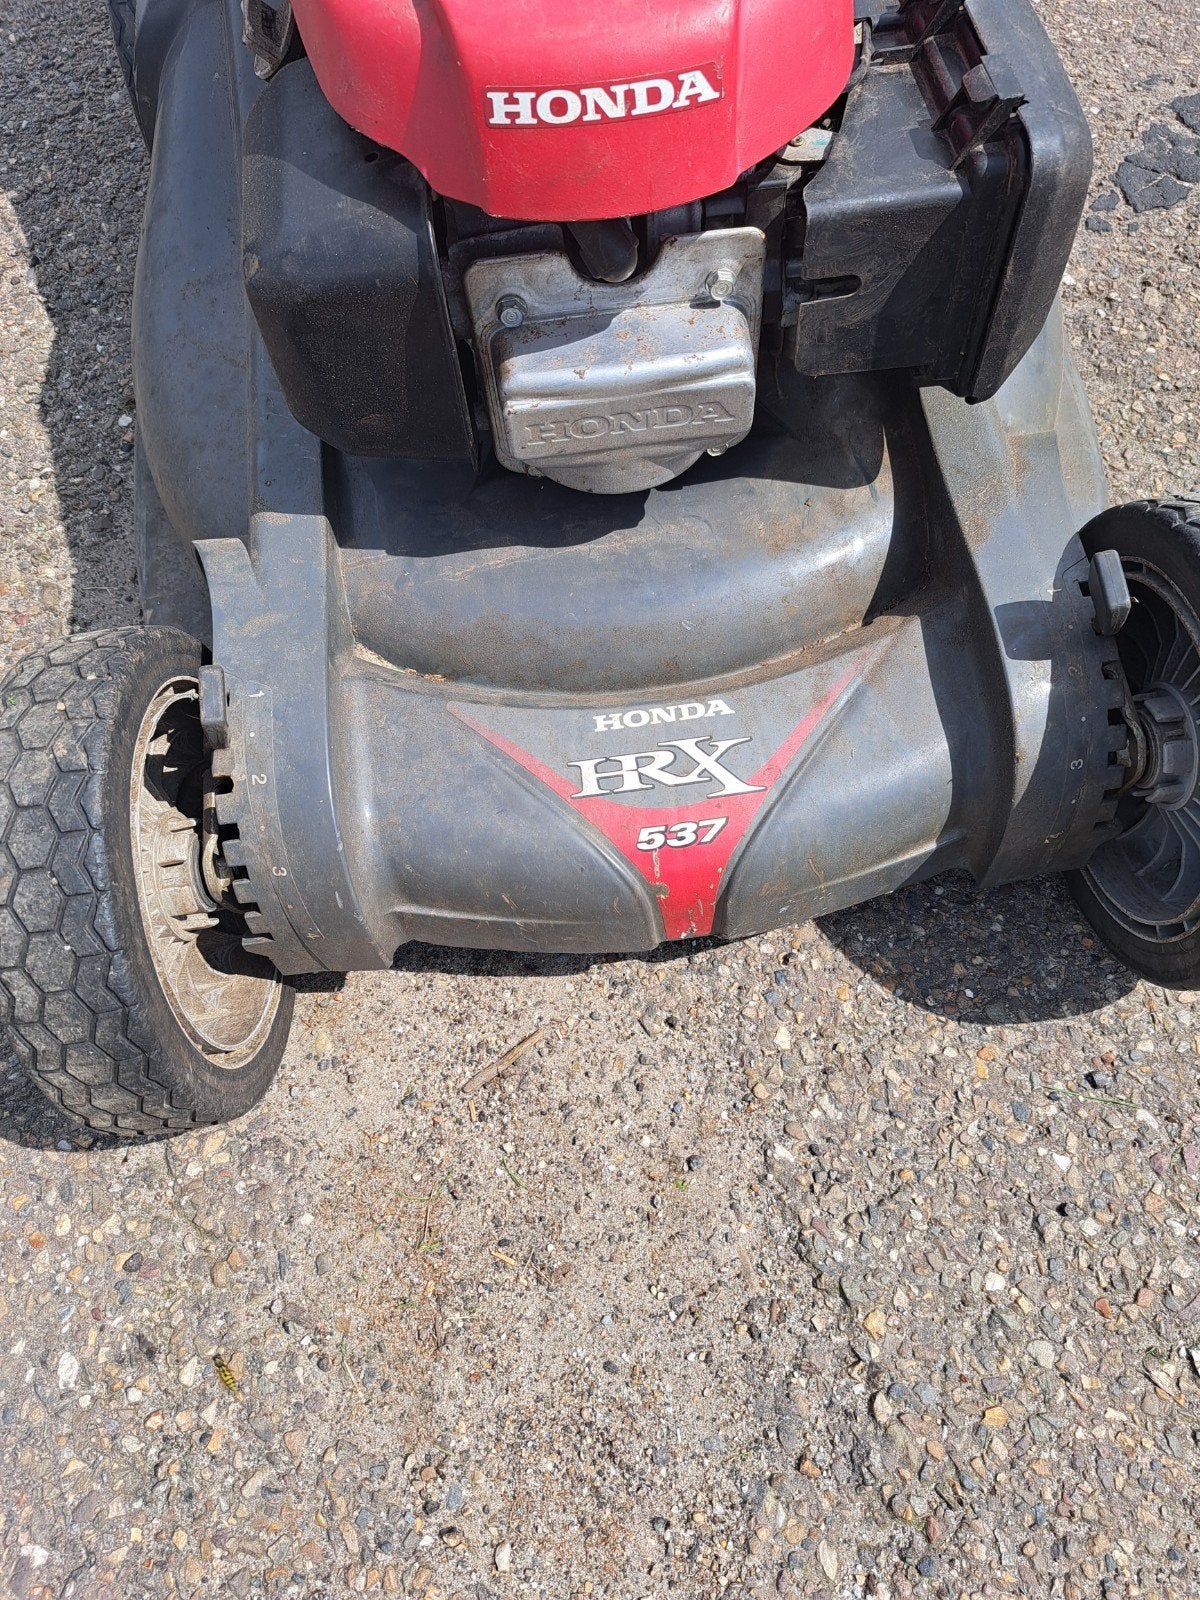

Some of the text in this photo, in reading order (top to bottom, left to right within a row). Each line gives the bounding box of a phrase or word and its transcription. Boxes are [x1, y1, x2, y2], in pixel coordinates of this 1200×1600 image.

[487, 70, 720, 124] HONDA
[524, 401, 736, 445] HONDA
[592, 699, 735, 732] HONDA
[251, 773, 267, 785] 2
[567, 736, 768, 799] HRX
[1070, 758, 1083, 769] 3
[636, 816, 729, 850] 537
[272, 866, 287, 877] 3
